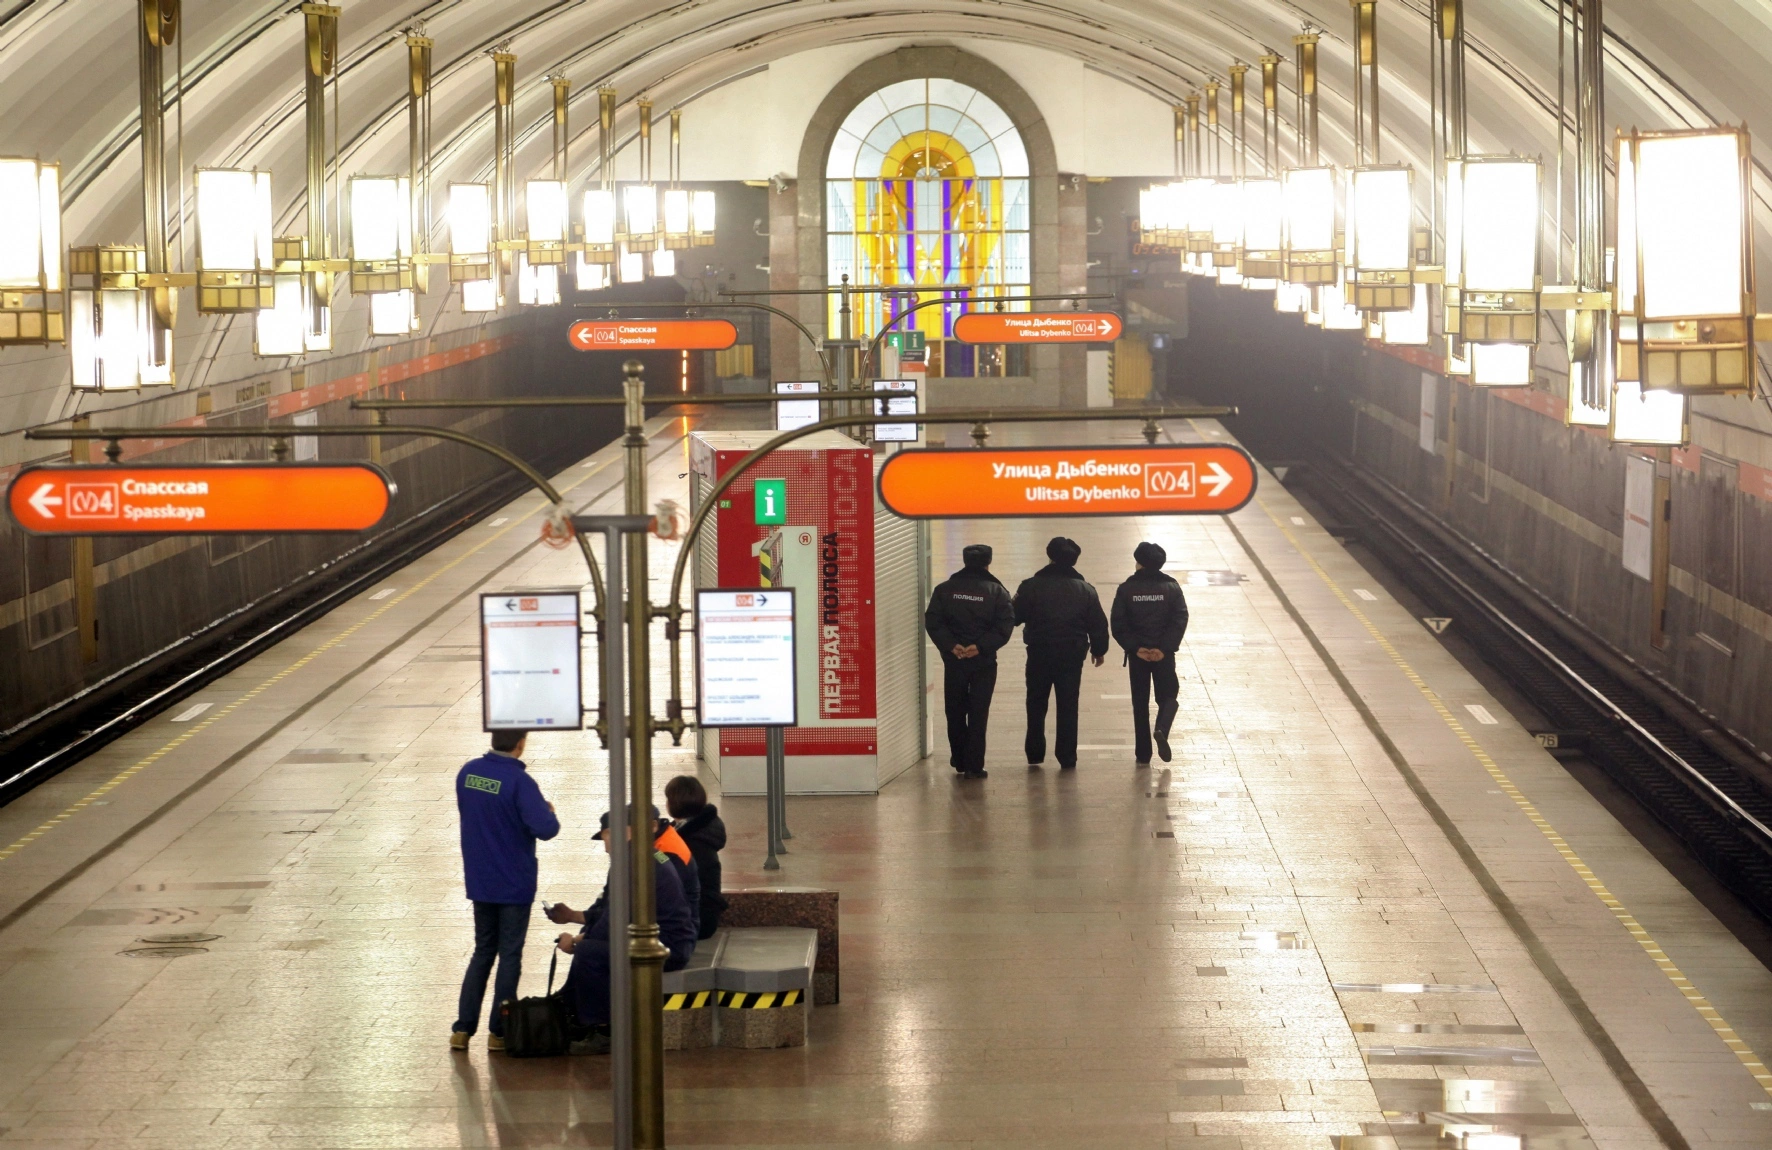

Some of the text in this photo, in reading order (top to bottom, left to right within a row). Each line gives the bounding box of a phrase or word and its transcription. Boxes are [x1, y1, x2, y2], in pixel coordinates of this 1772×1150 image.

[1005, 318, 1072, 328] Улица Дыбенко
[618, 325, 657, 334] Спасская
[1040, 329, 1072, 338] Dybenko
[618, 336, 656, 345] Spasskaya
[992, 459, 1142, 481] Улица Дыбенко
[121, 478, 209, 496] Спасская
[1025, 484, 1142, 504] Ulitsa Dybenko
[122, 503, 206, 521] Spasskaya
[953, 593, 984, 602] ПОЛИЦИЯ
[1132, 594, 1164, 602] ПОЛИЦИЯ
[822, 531, 842, 714] ПЕРВАЯ ПОЛОСА
[1540, 735, 1555, 746] 76
